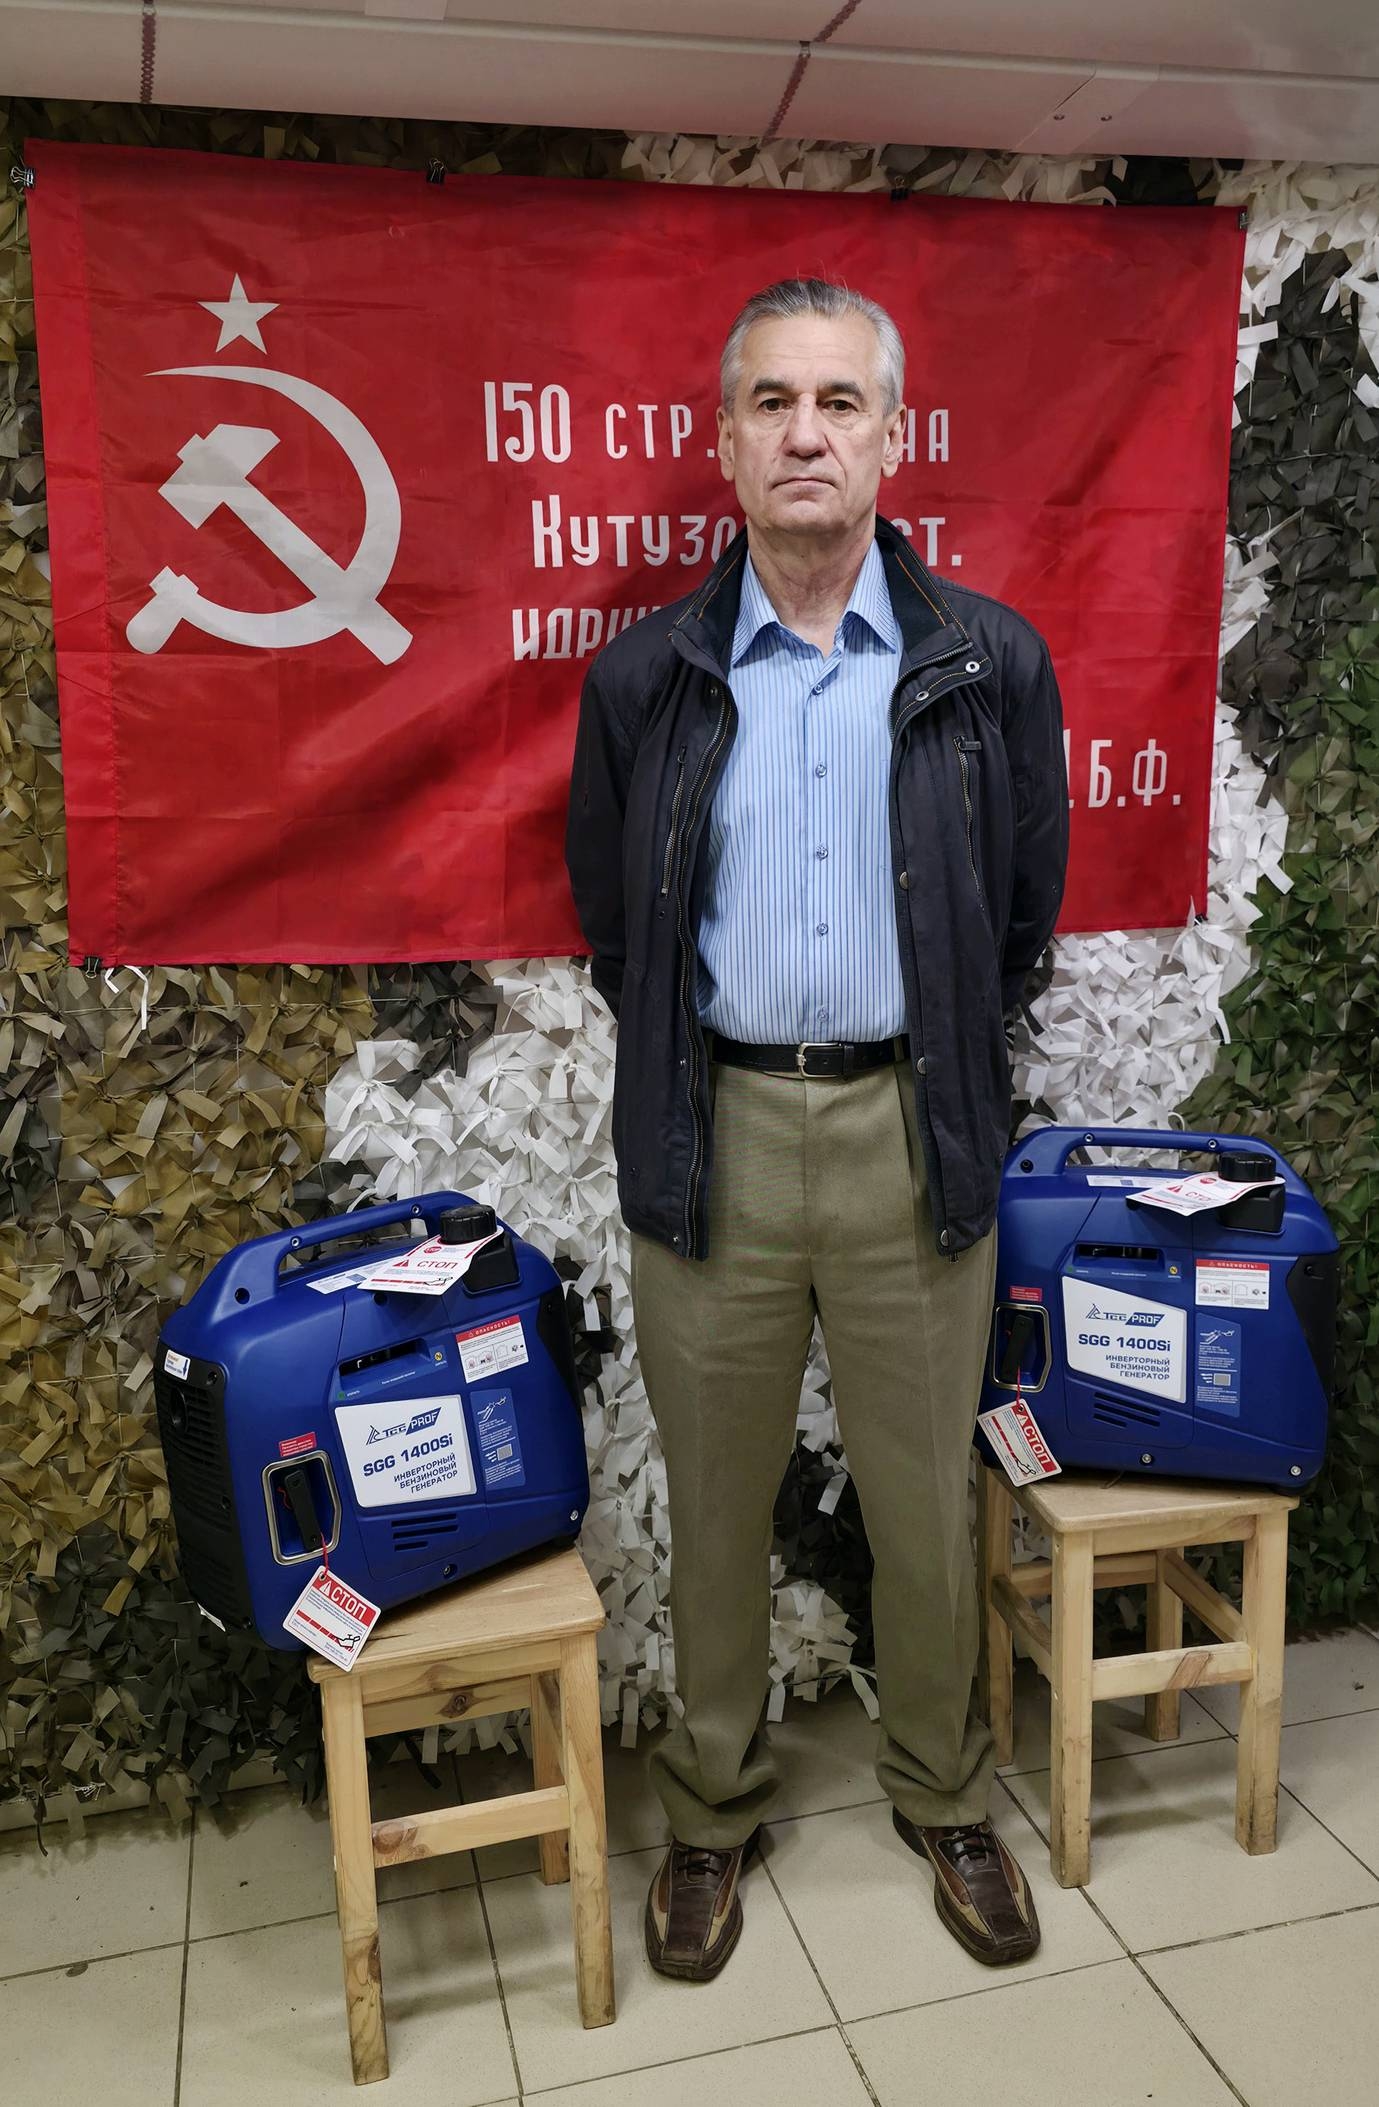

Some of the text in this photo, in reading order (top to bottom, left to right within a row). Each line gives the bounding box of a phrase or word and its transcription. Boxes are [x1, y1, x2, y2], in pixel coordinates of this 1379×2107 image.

[484, 381, 572, 464] 150
[417, 1260, 458, 1270] СТОП
[1132, 1314, 1160, 1325] PROF
[1078, 1333, 1171, 1352] SGG 1400Si
[1105, 1354, 1170, 1366] ИНВЕРТОРНЫЙ
[1110, 1362, 1170, 1373] БЕНЗИНОВЫЙ
[1120, 1371, 1170, 1381] ГЕНЕРАТОР
[410, 1412, 439, 1429] PROF
[363, 1455, 396, 1477] SGG
[401, 1433, 453, 1462] 1400Si
[1023, 1426, 1051, 1465] СТОП
[394, 1452, 456, 1482] ИНВЕРТОРНЫЙ
[400, 1461, 457, 1489] БЕНЗИНОВЫЙ
[411, 1470, 458, 1493] ГЕНЕРАТОР
[330, 1586, 367, 1621] СТОП
